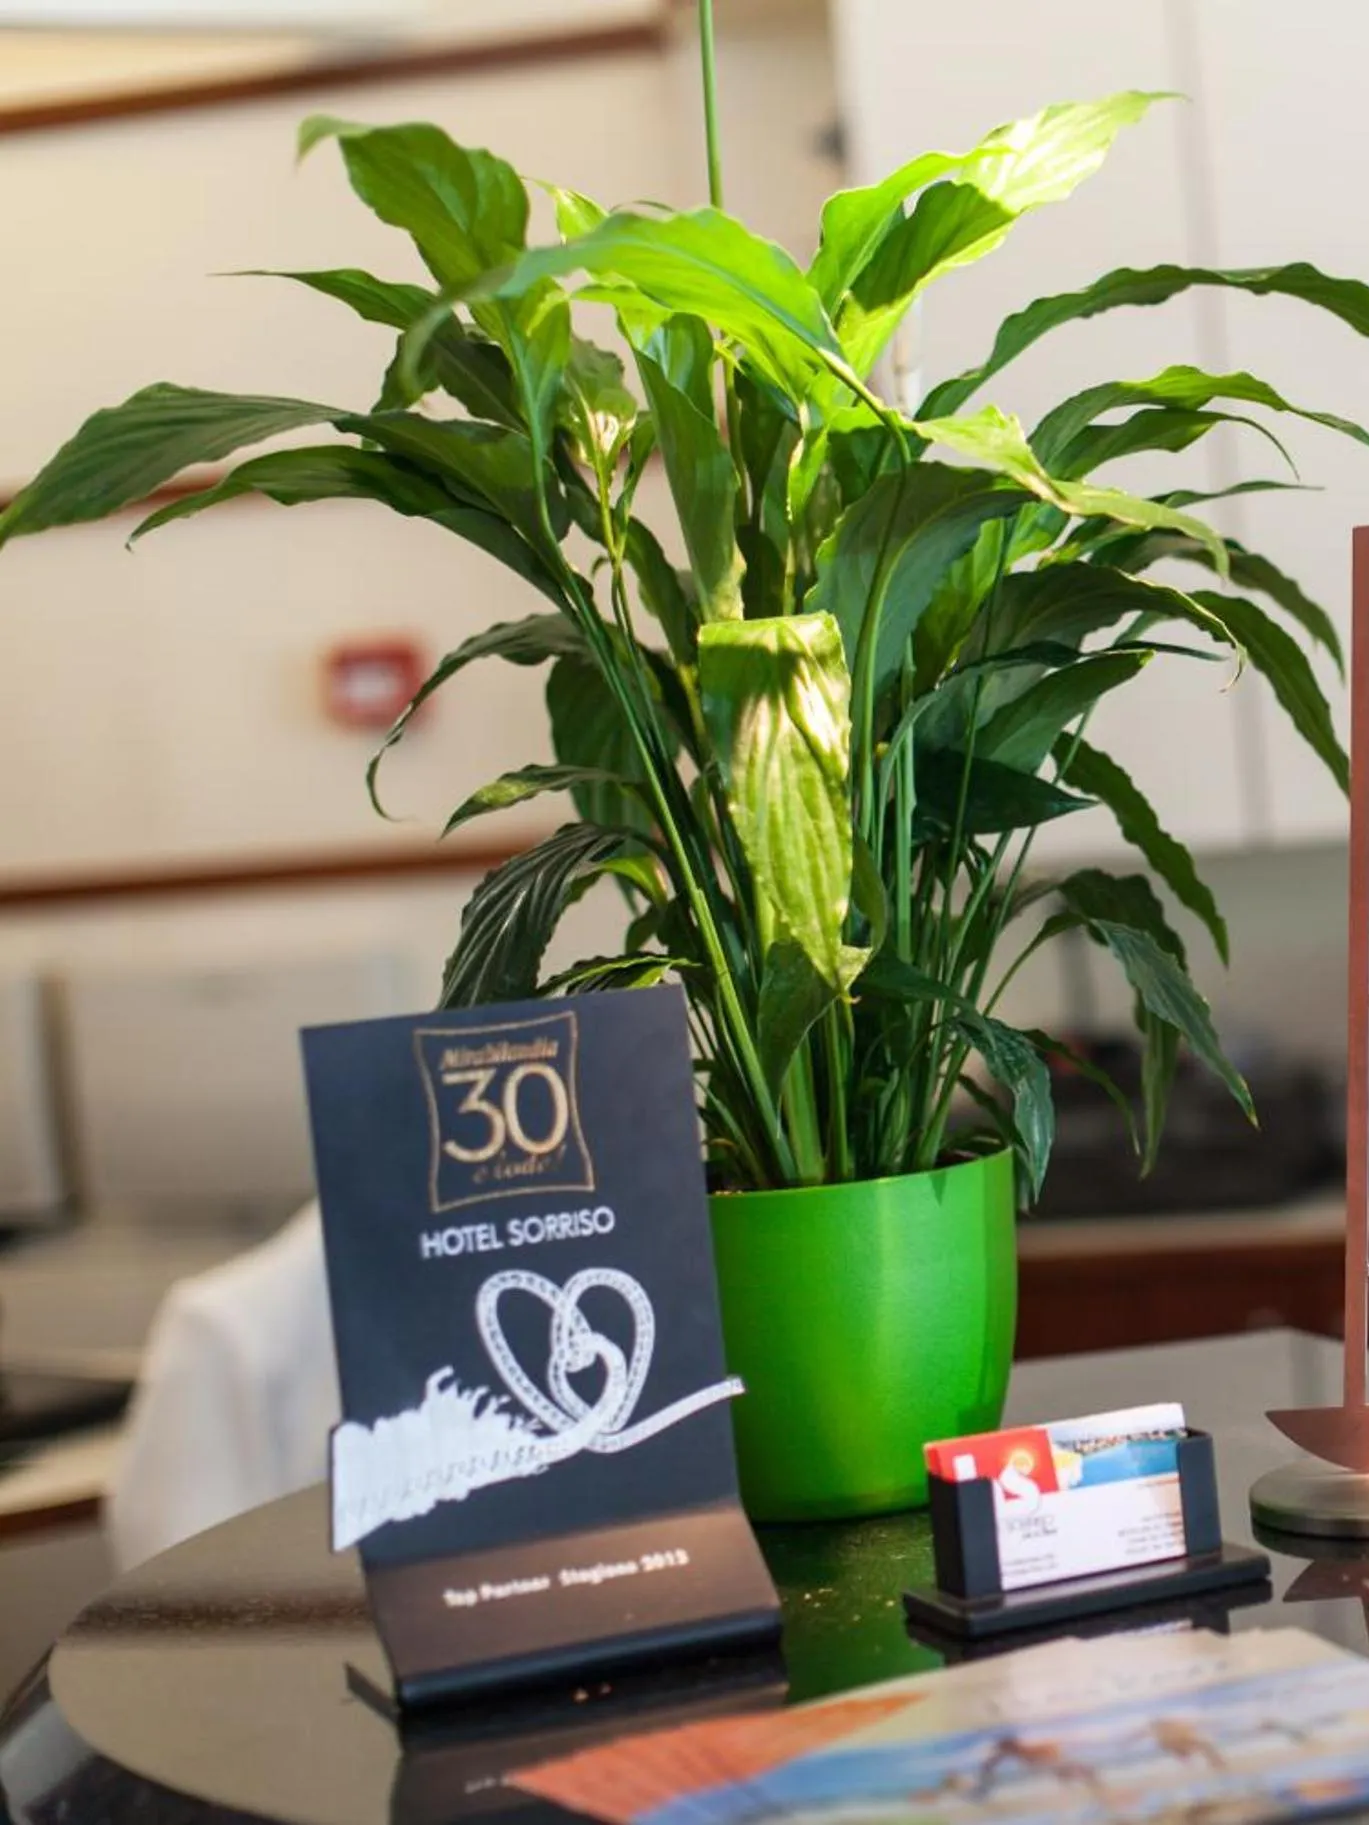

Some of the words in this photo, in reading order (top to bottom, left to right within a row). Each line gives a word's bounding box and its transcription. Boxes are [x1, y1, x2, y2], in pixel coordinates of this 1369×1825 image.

[441, 1062, 568, 1162] 30
[419, 1223, 504, 1259] HOTEL
[507, 1206, 616, 1247] SORRISO
